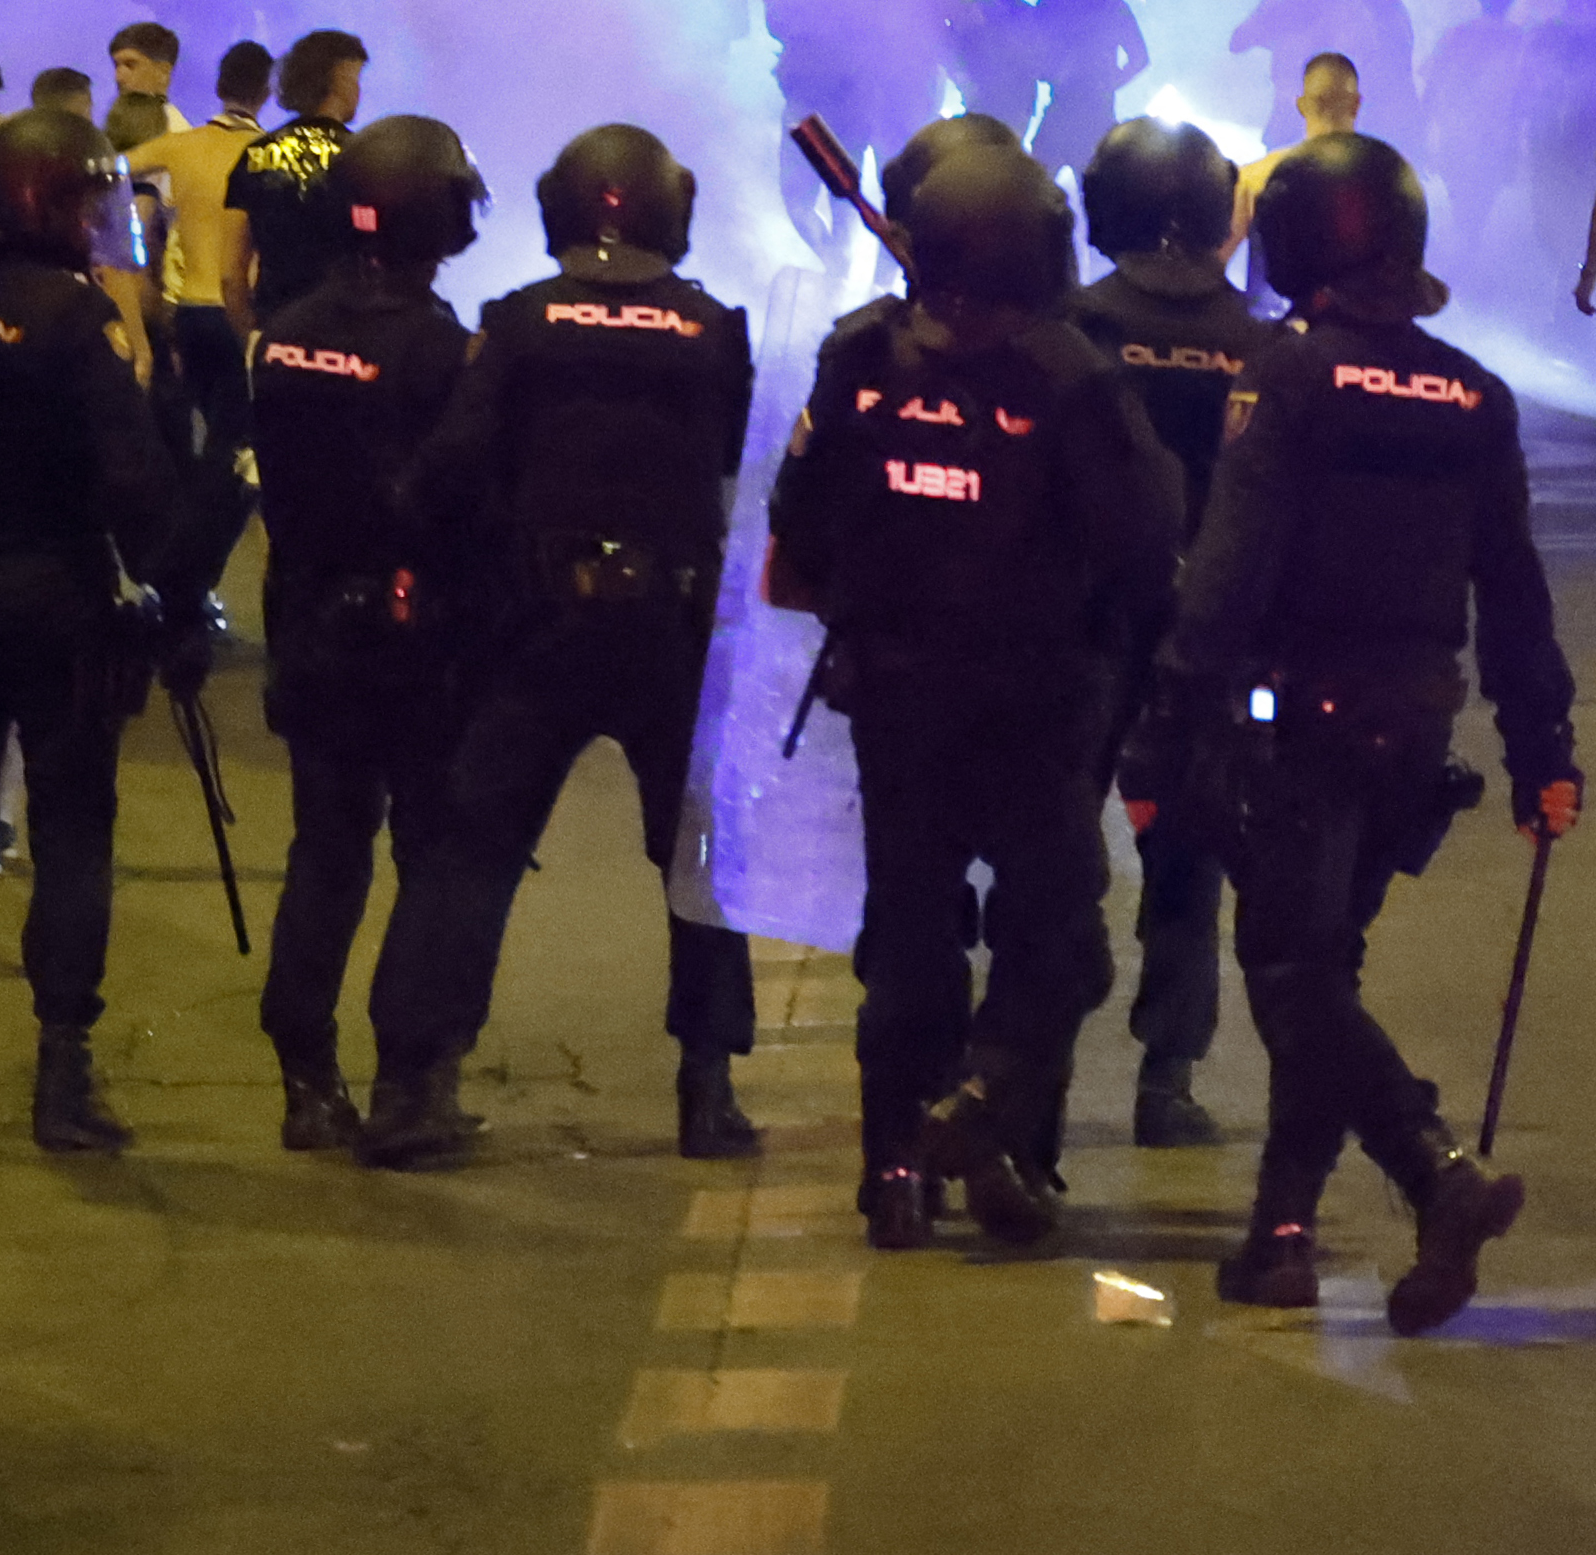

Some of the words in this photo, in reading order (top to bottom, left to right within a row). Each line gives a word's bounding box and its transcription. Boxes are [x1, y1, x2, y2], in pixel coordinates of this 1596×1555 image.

[546, 303, 683, 332] POLICIA
[265, 342, 364, 378] POLICIA
[1334, 364, 1466, 405] POLICIA
